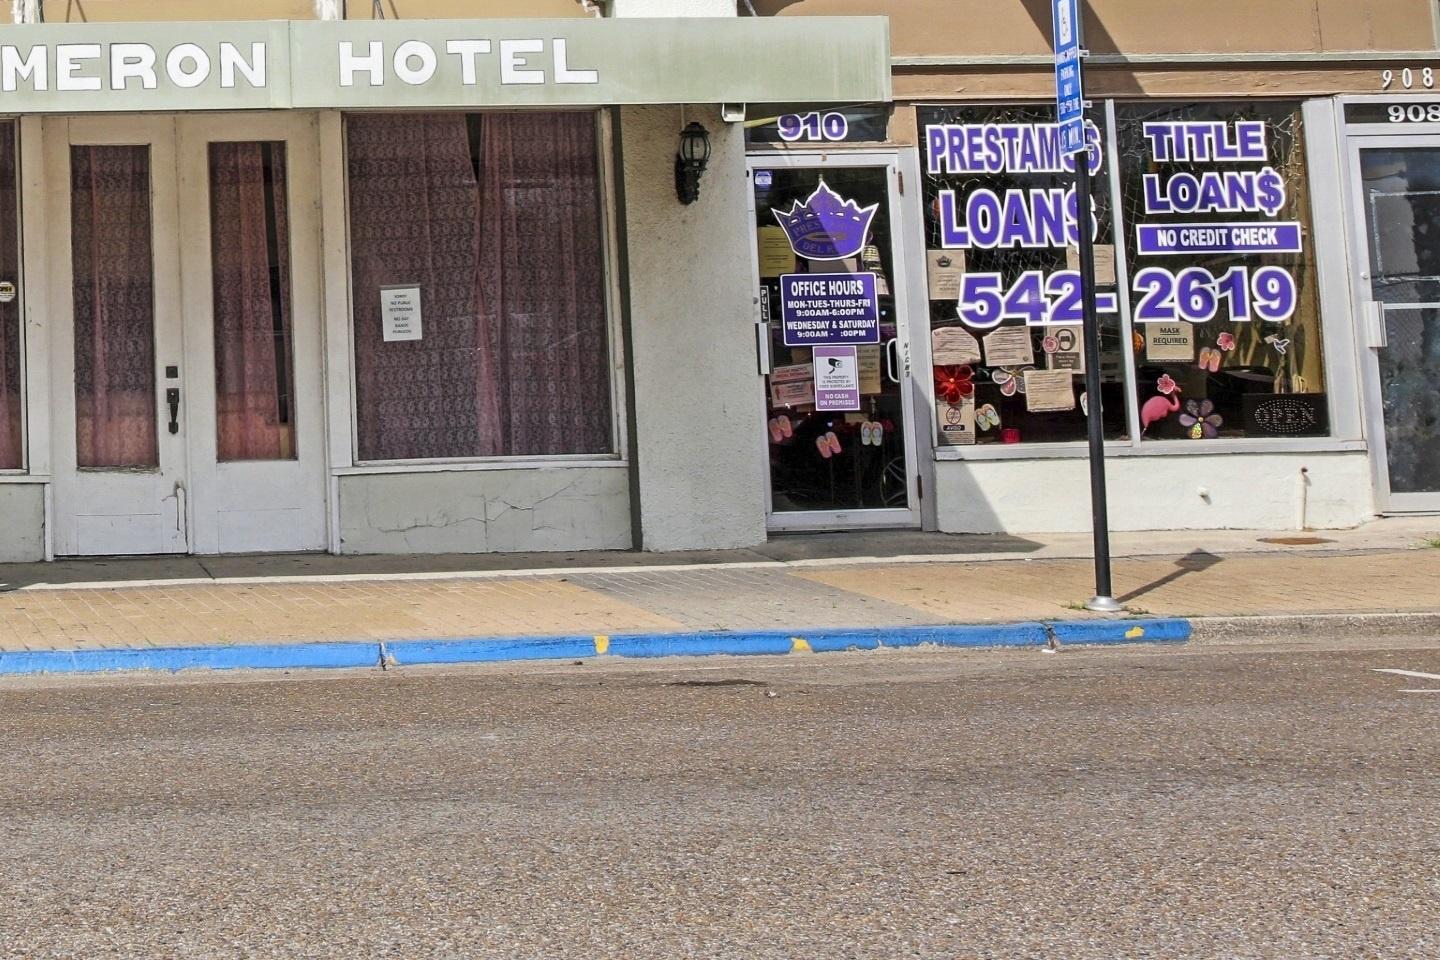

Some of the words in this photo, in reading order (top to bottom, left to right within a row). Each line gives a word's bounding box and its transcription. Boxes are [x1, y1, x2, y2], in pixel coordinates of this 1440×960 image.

[338, 38, 600, 87] HOTEL
[1381, 67, 1434, 89] 908
[1387, 104, 1440, 123] 908
[776, 111, 849, 142] 910
[925, 123, 1103, 176] PRESTAM$
[1143, 121, 1268, 162] TITLE
[1142, 166, 1286, 217] LOAN$
[1157, 229, 1177, 247] NO
[1180, 229, 1228, 246] CREDIT
[1231, 228, 1278, 246] CHECK
[791, 281, 826, 296] OFFICE
[829, 280, 864, 295] HOURS
[760, 289, 768, 320] PULL
[787, 299, 871, 309] MON-TUES-THURS-FRI
[796, 308, 865, 317] 9:00AM-6:00PM
[787, 321, 829, 330] WEDNESDAY
[832, 321, 837, 329] &
[839, 320, 876, 329] SATURDAY
[1153, 337, 1188, 345] REQUIRED
[1254, 407, 1317, 423] OPEN
